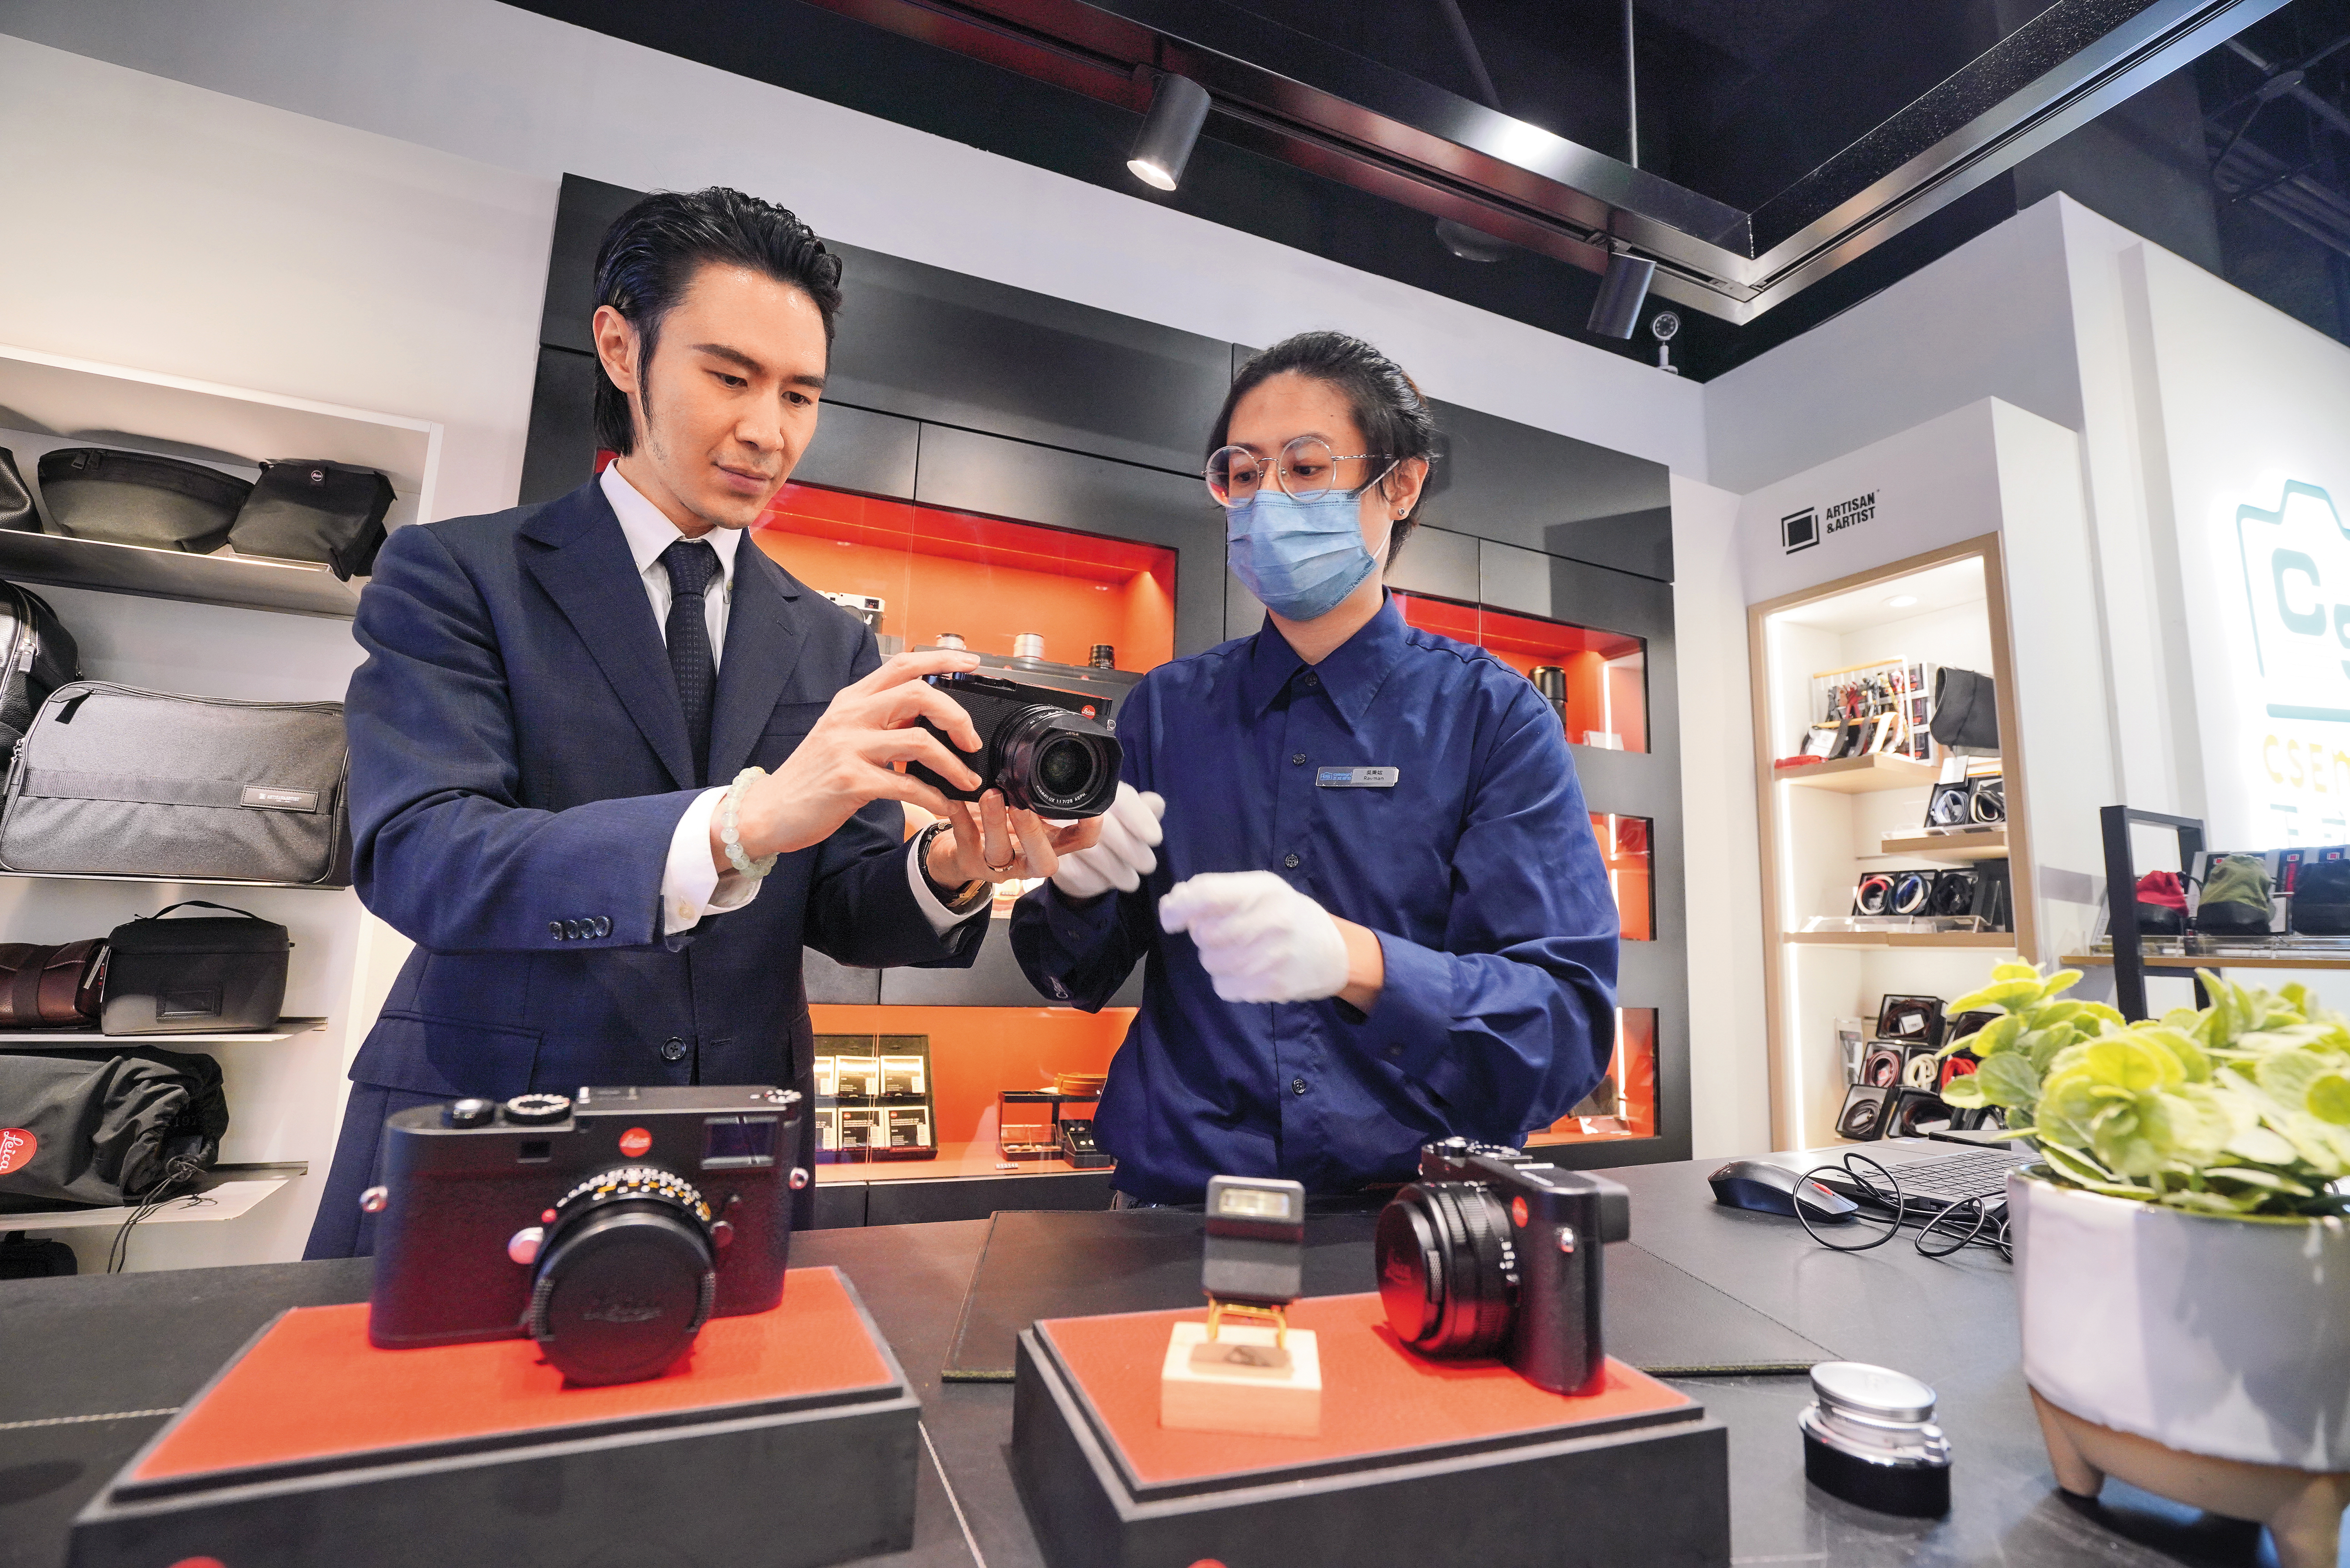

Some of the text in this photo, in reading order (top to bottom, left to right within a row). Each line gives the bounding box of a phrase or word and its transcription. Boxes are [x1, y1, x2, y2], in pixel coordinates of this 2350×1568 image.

[1827, 492, 1875, 519] ARTISAN
[1827, 506, 1875, 533] &ARTIST
[1075, 792, 1087, 802] ASPH.
[0, 1131, 24, 1171] Leica
